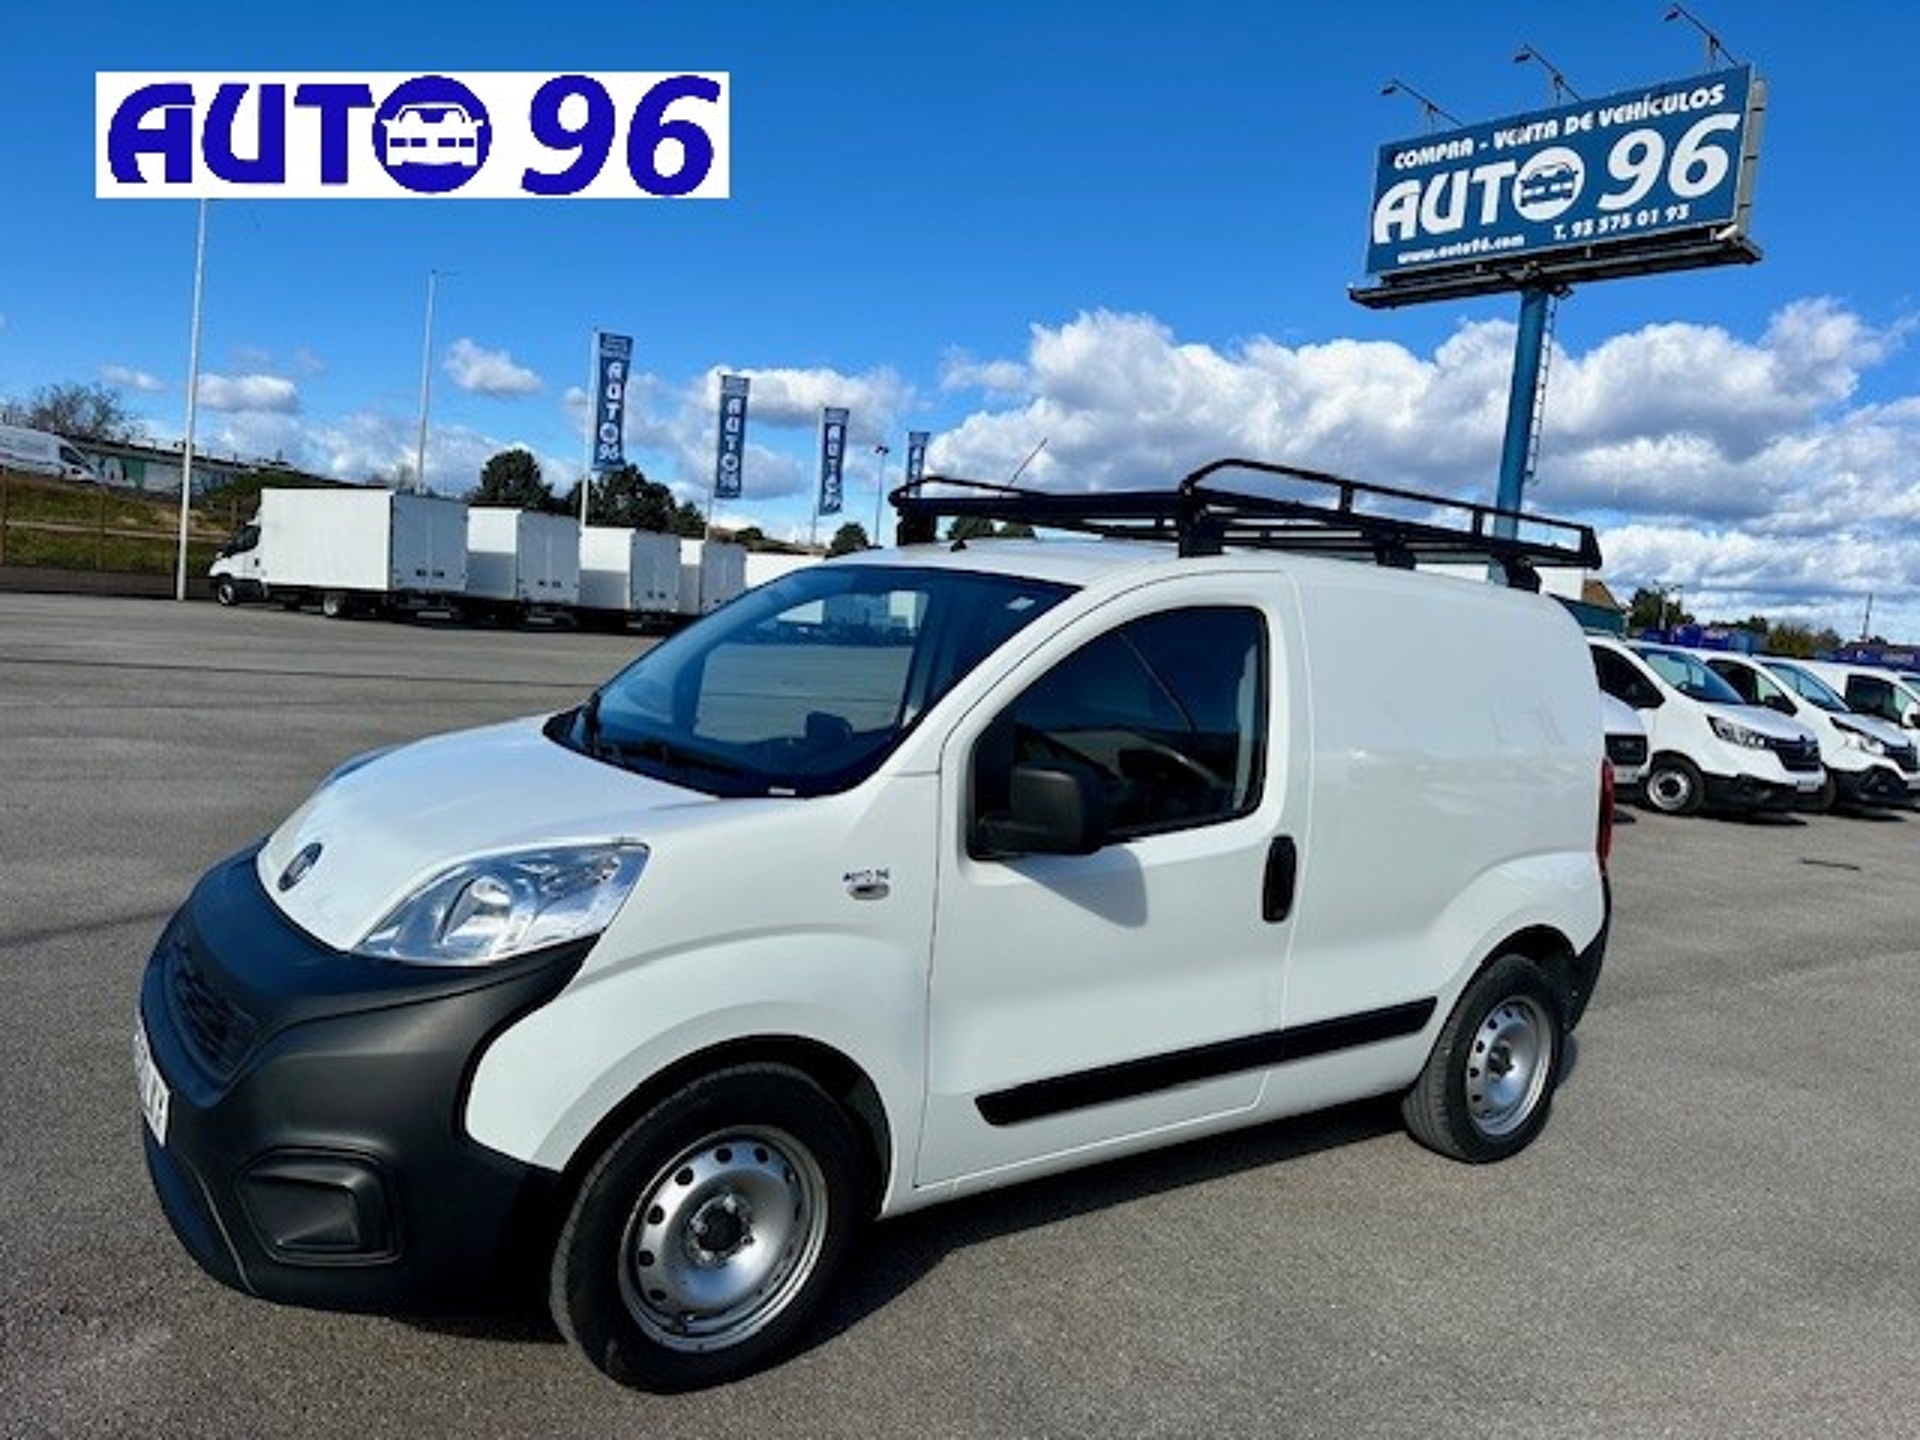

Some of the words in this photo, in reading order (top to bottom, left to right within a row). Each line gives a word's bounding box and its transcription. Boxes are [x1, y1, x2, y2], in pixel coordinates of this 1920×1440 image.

[1372, 146, 1585, 244] AUTO
[1597, 113, 1741, 212] 96
[1394, 136, 1474, 170] COMPRA
[1493, 119, 1558, 150] VENTA
[1563, 111, 1594, 135] DE
